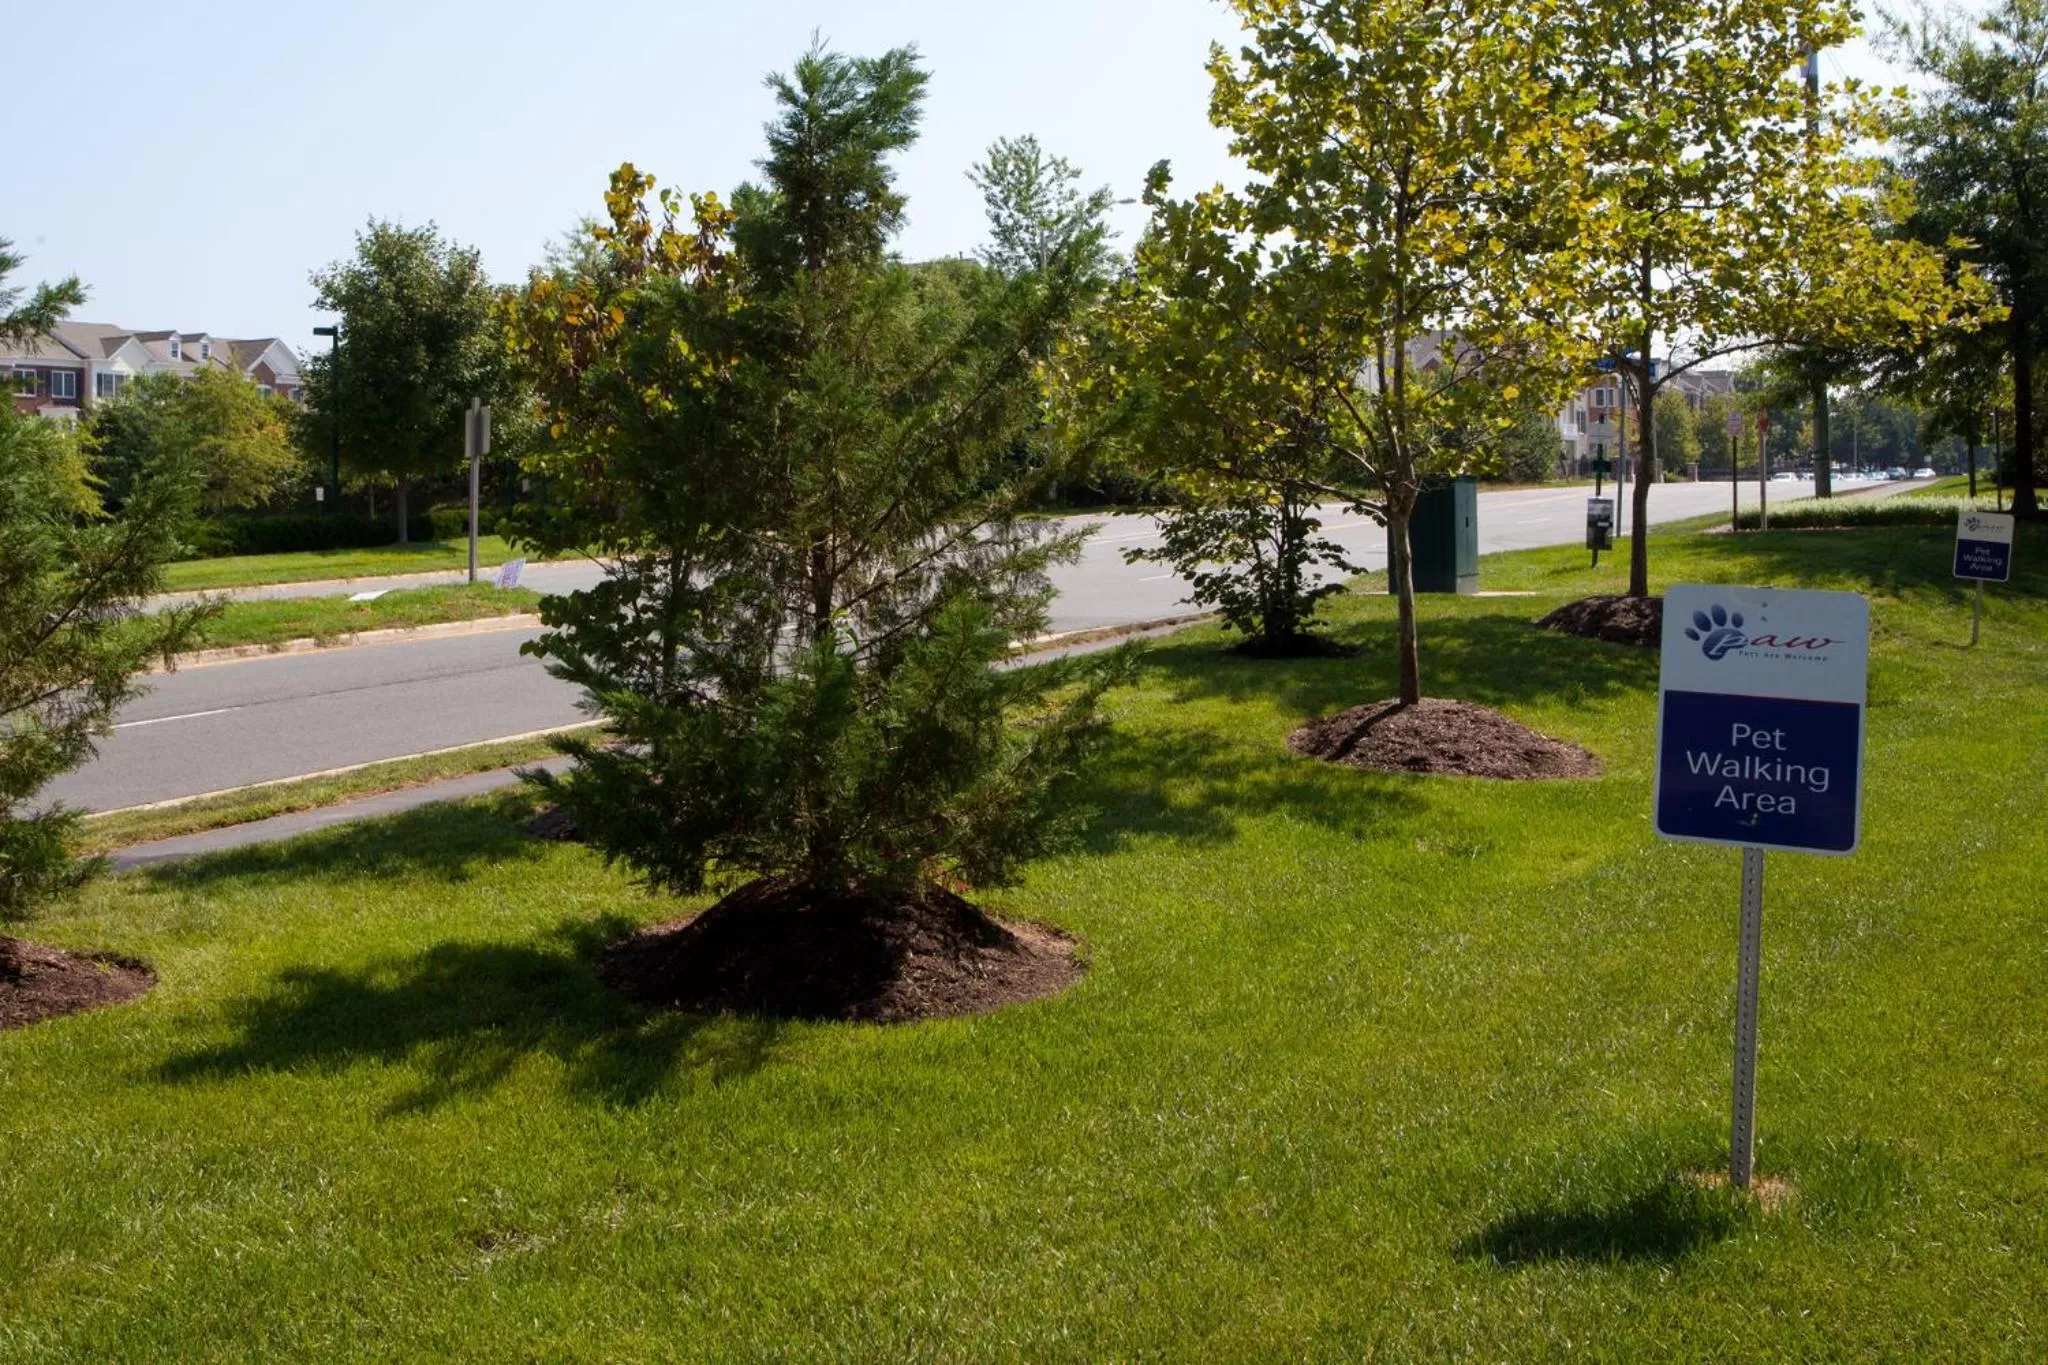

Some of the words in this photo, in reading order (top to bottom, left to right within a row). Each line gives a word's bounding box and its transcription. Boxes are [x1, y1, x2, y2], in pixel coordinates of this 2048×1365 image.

[1731, 722, 1787, 751] Pet
[1686, 750, 1830, 793] Walking
[1714, 784, 1797, 815] Area
